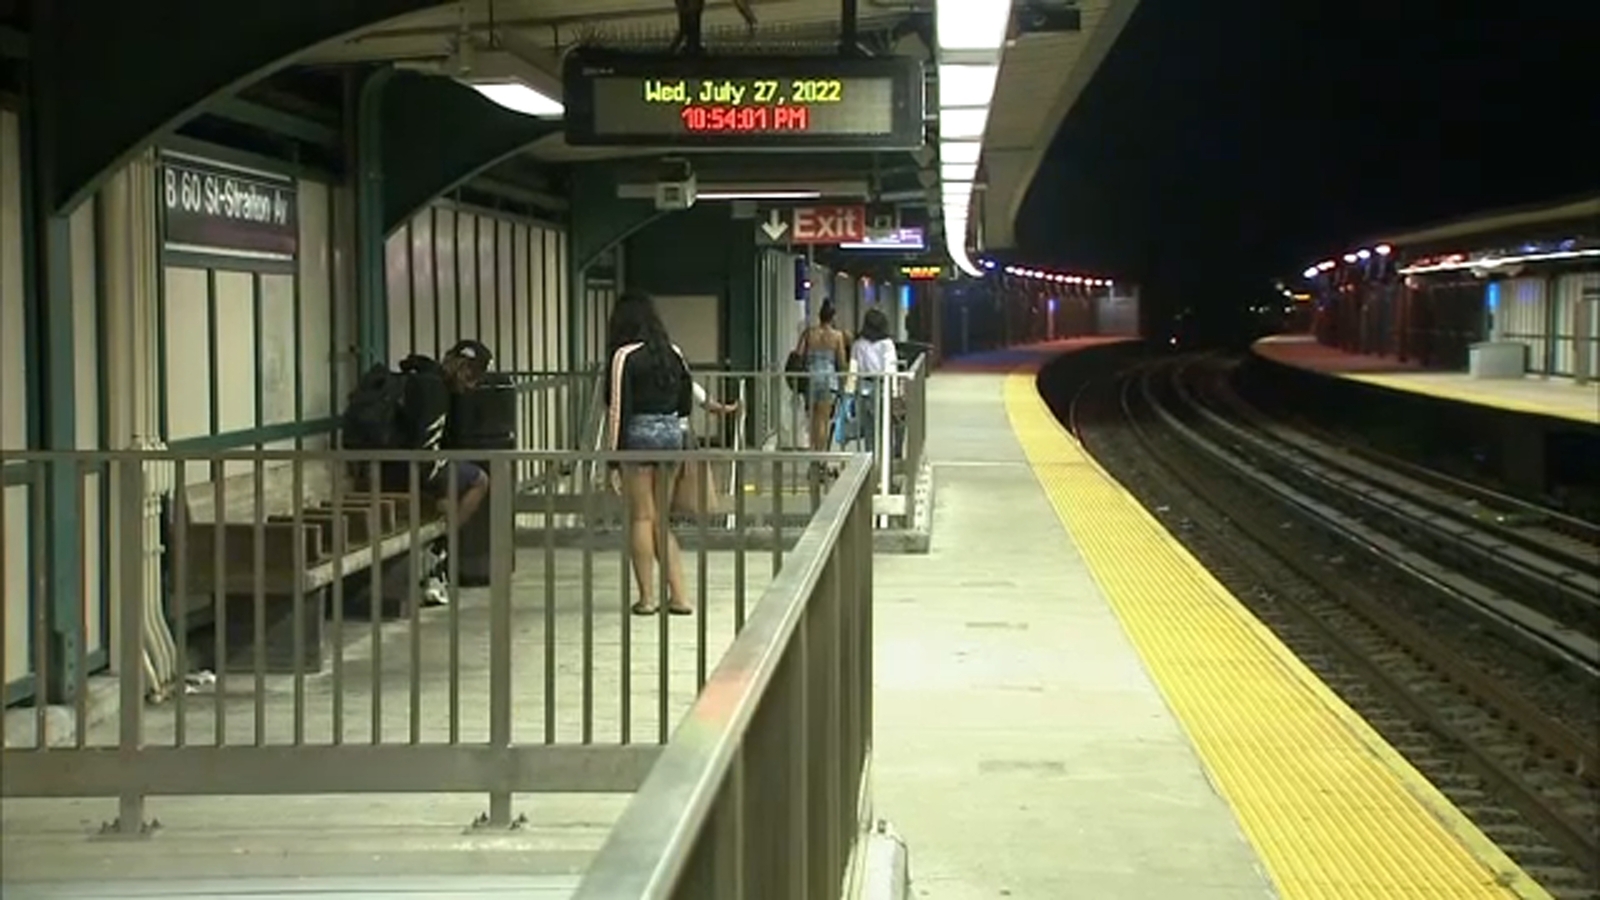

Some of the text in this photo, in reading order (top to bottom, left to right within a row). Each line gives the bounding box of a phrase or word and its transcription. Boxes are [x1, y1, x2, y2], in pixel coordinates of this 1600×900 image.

[645, 81, 841, 105] Wed, July 27, 2022
[682, 108, 808, 129] 10:54:01 PM
[165, 168, 177, 209] B
[181, 172, 202, 213] 60
[793, 208, 856, 238] Exit
